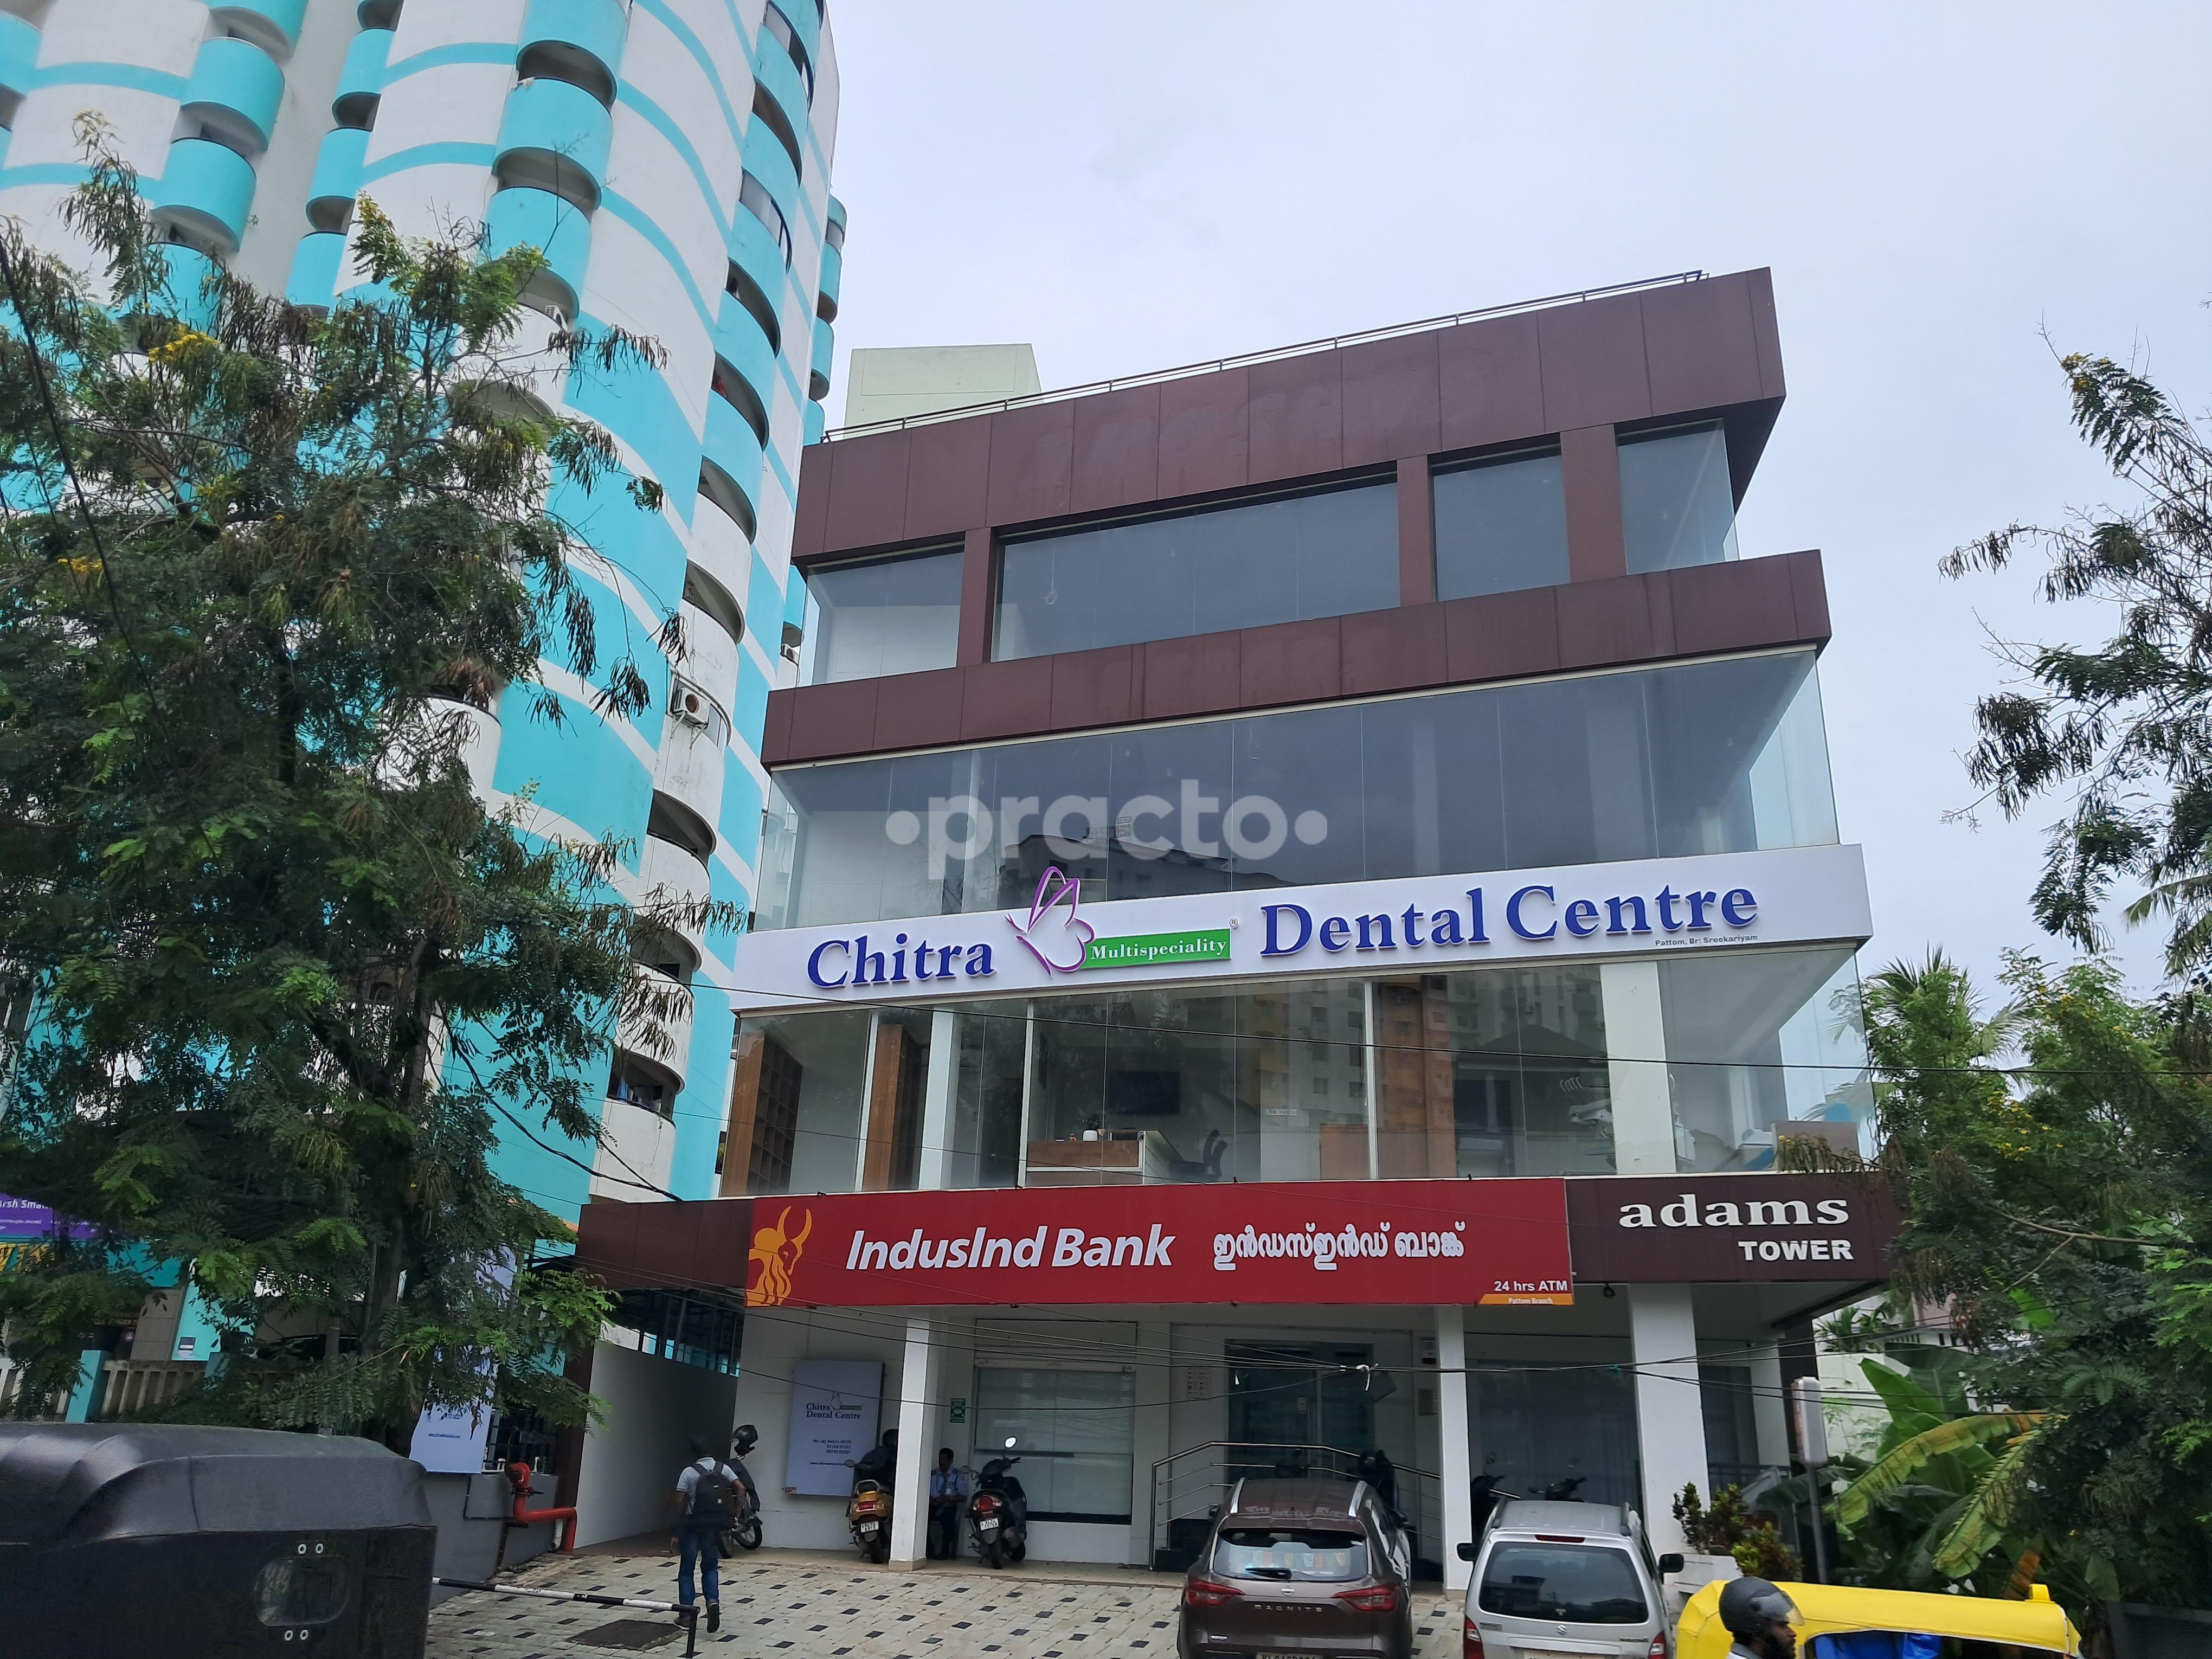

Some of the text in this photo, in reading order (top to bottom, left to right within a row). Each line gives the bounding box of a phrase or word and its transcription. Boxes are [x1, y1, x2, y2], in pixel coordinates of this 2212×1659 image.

[1259, 883, 1758, 959] Dental Centre
[807, 933, 996, 990] Chitra
[1090, 936, 1226, 961] Multispeciality
[1619, 1194, 1849, 1227] adams
[846, 1224, 1176, 1270] IndusInd Bank
[1738, 1240, 1854, 1261] TOWER
[1494, 1280, 1568, 1291] 24 hrs ATM
